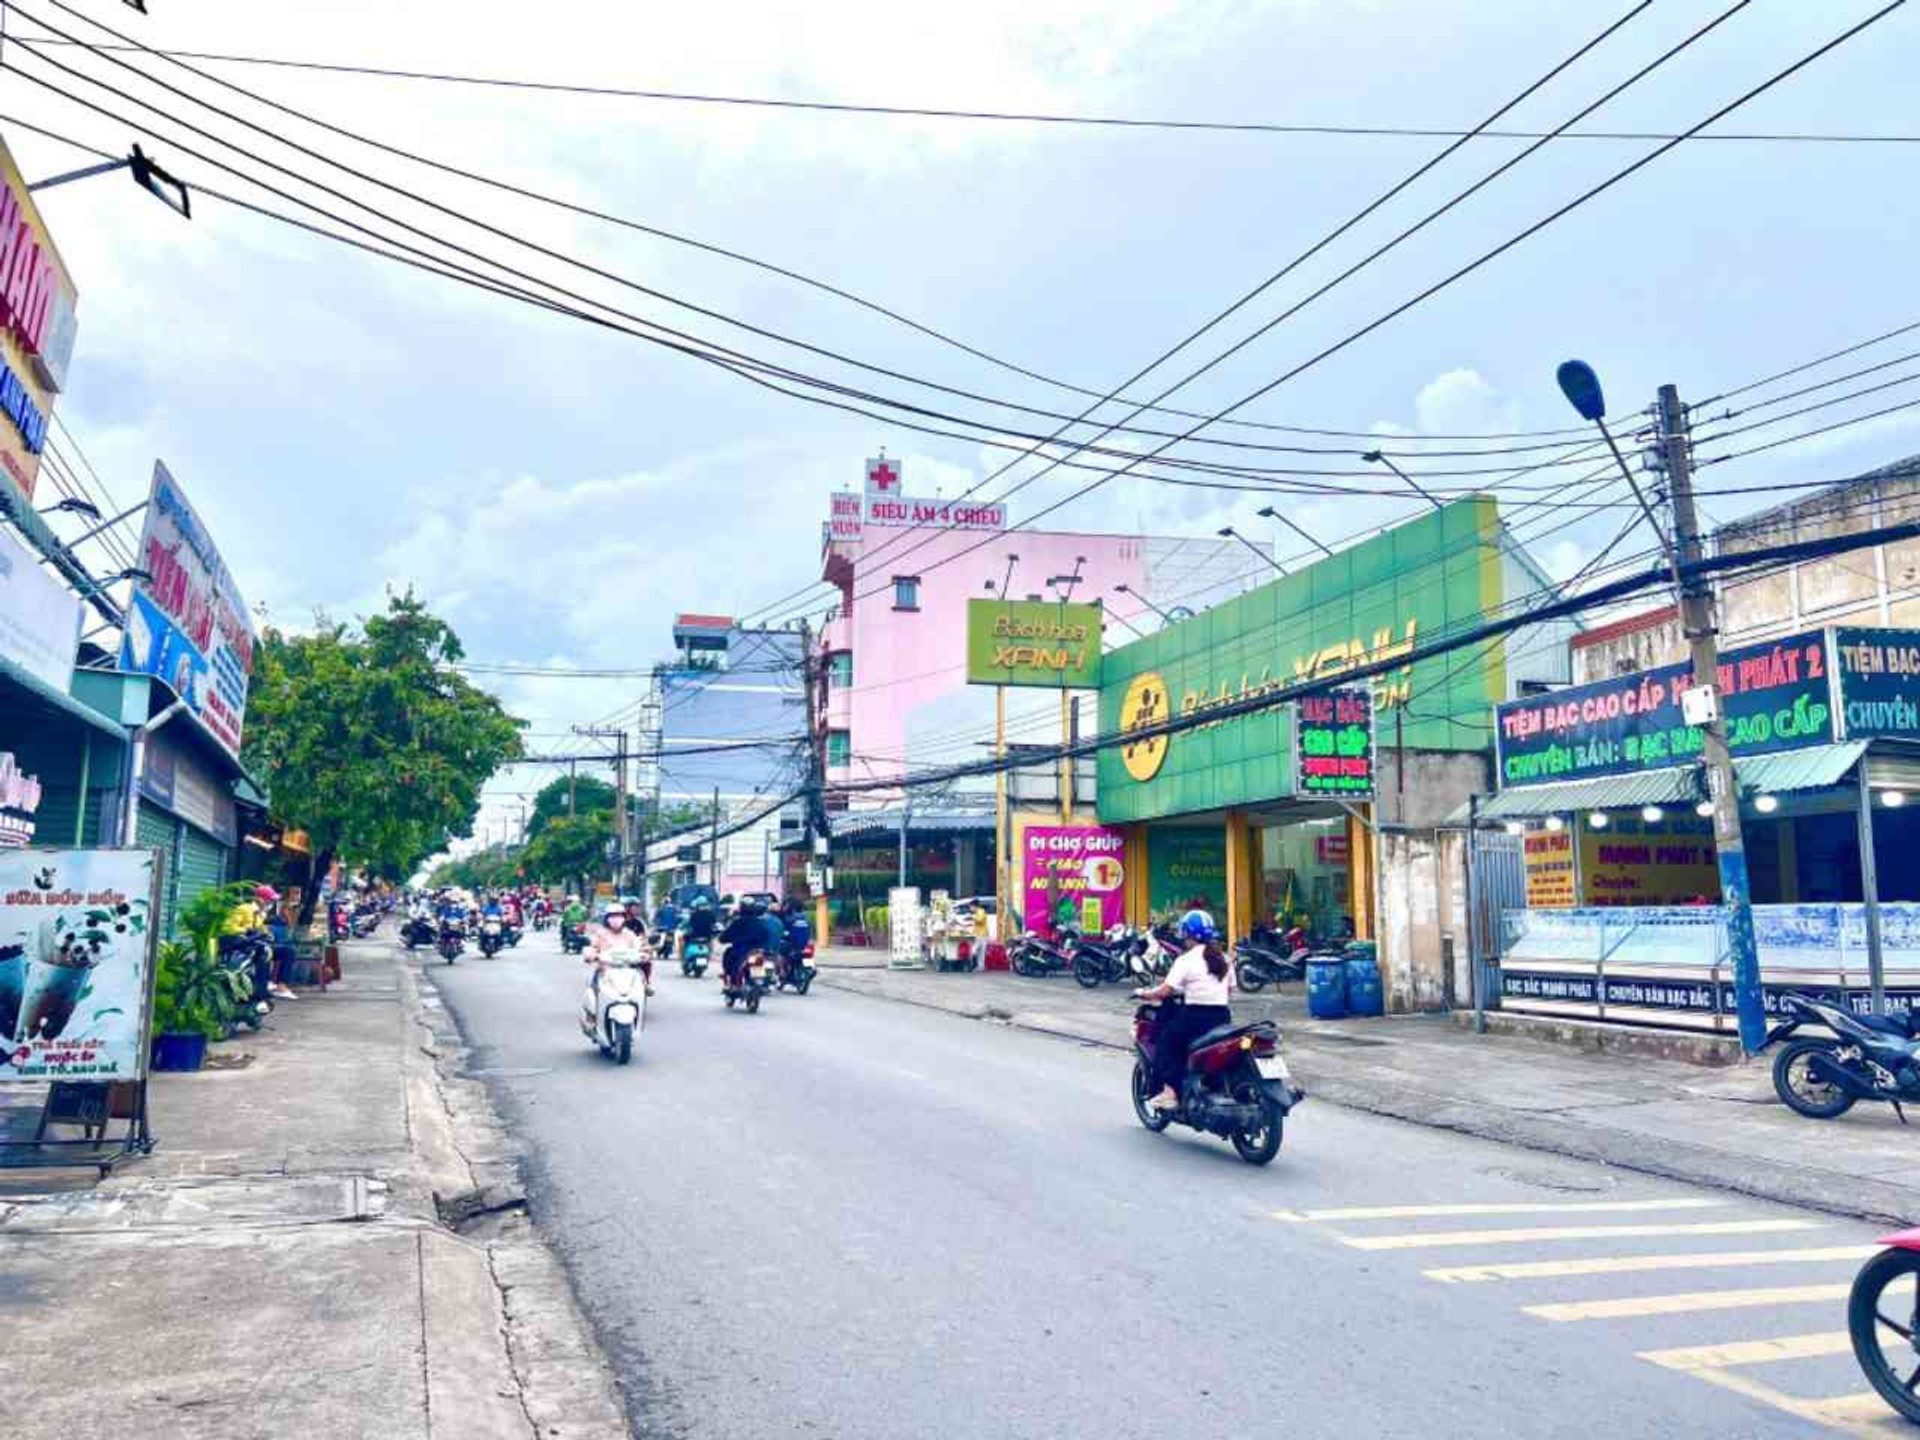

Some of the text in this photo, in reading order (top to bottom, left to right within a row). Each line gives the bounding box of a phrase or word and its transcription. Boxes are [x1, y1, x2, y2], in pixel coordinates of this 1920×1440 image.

[988, 646, 1086, 672] XANH
[1843, 640, 1884, 682] TIỆM
[1502, 705, 1542, 743] TIỆM
[1544, 702, 1581, 733] BẠC
[1583, 693, 1620, 723] CAO
[1624, 676, 1665, 715] CẤP
[1738, 646, 1800, 691] PHÁT
[1806, 645, 1824, 678] 2
[1848, 694, 1918, 730] CHUYÊN
[1505, 742, 1572, 782] CHUYÊN
[1774, 692, 1828, 737] CẤP
